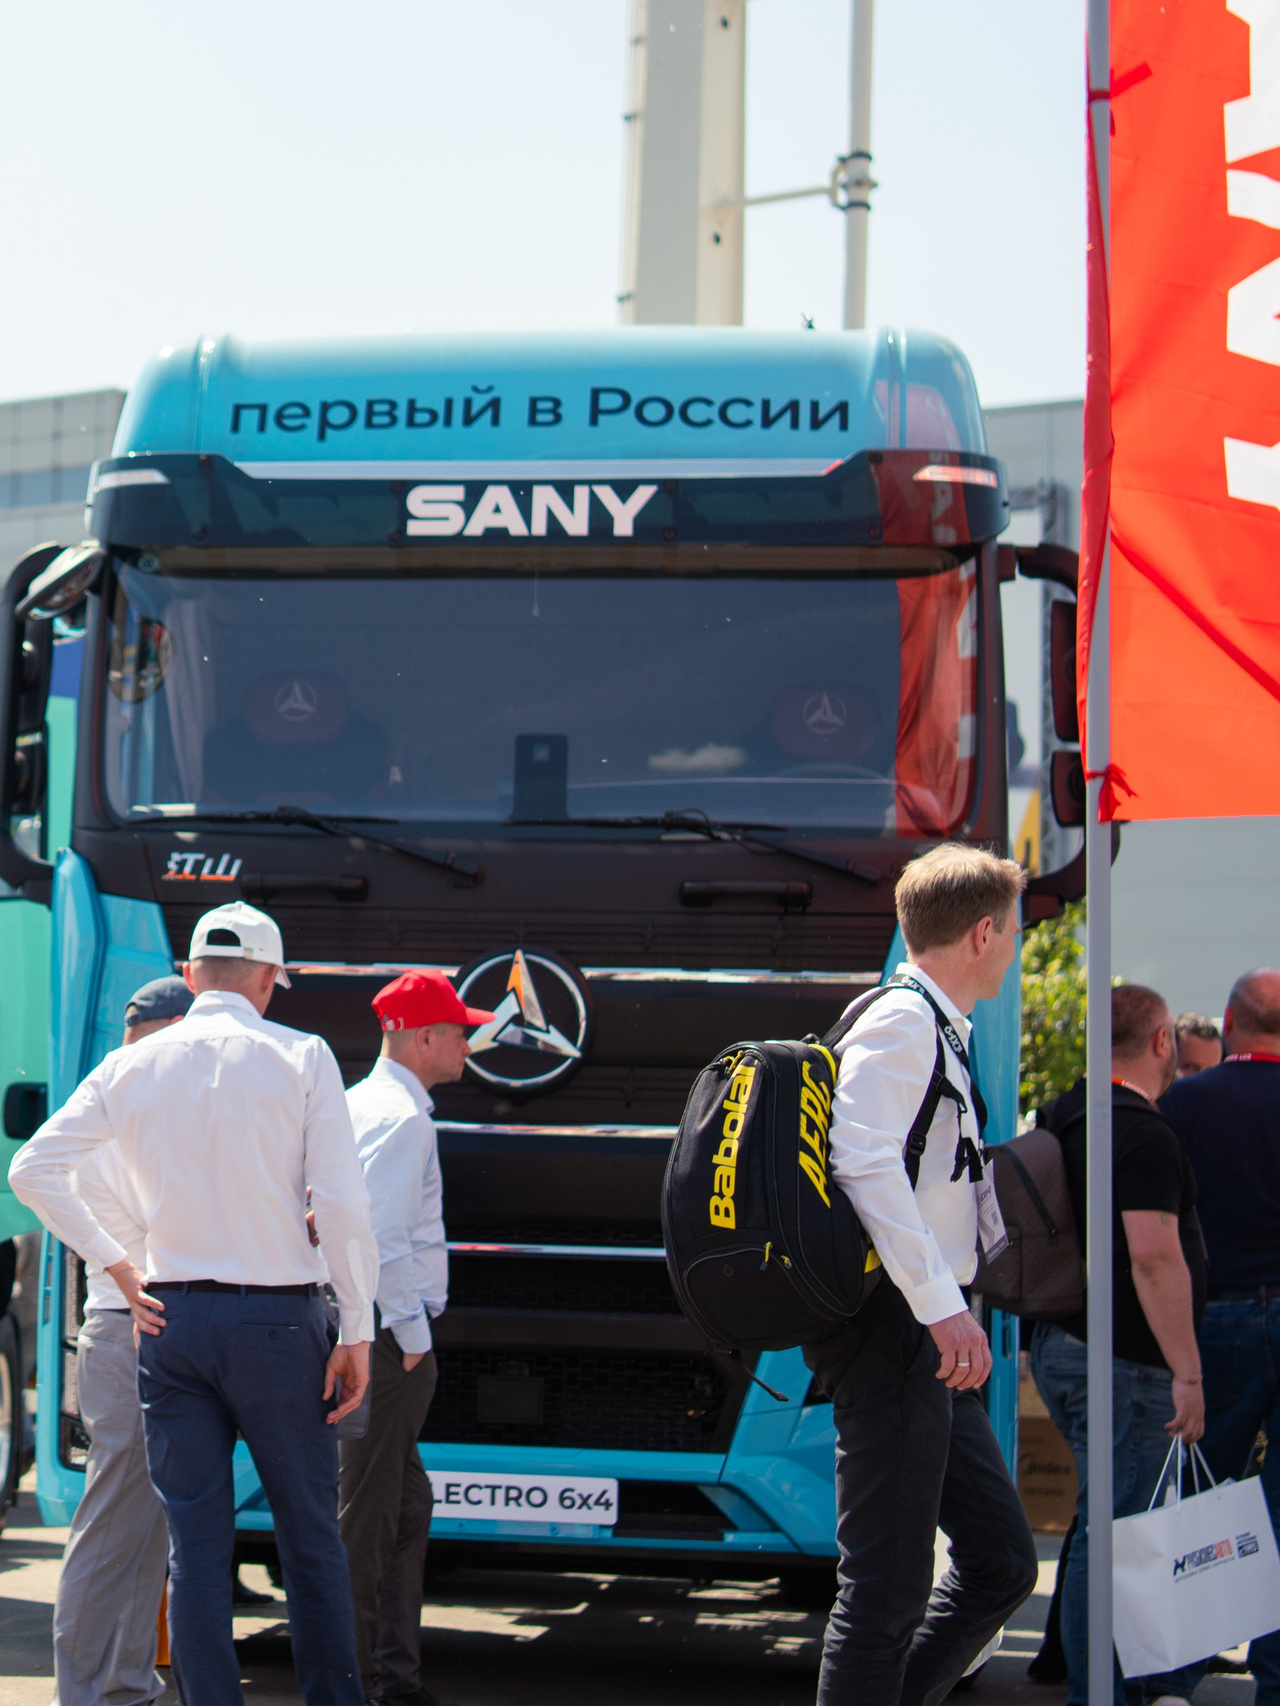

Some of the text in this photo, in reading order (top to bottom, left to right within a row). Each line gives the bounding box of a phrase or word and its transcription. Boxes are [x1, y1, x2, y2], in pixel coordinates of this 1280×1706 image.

[230, 385, 849, 441] первый в России
[406, 485, 659, 536] SANY
[558, 1487, 614, 1512] 6x4
